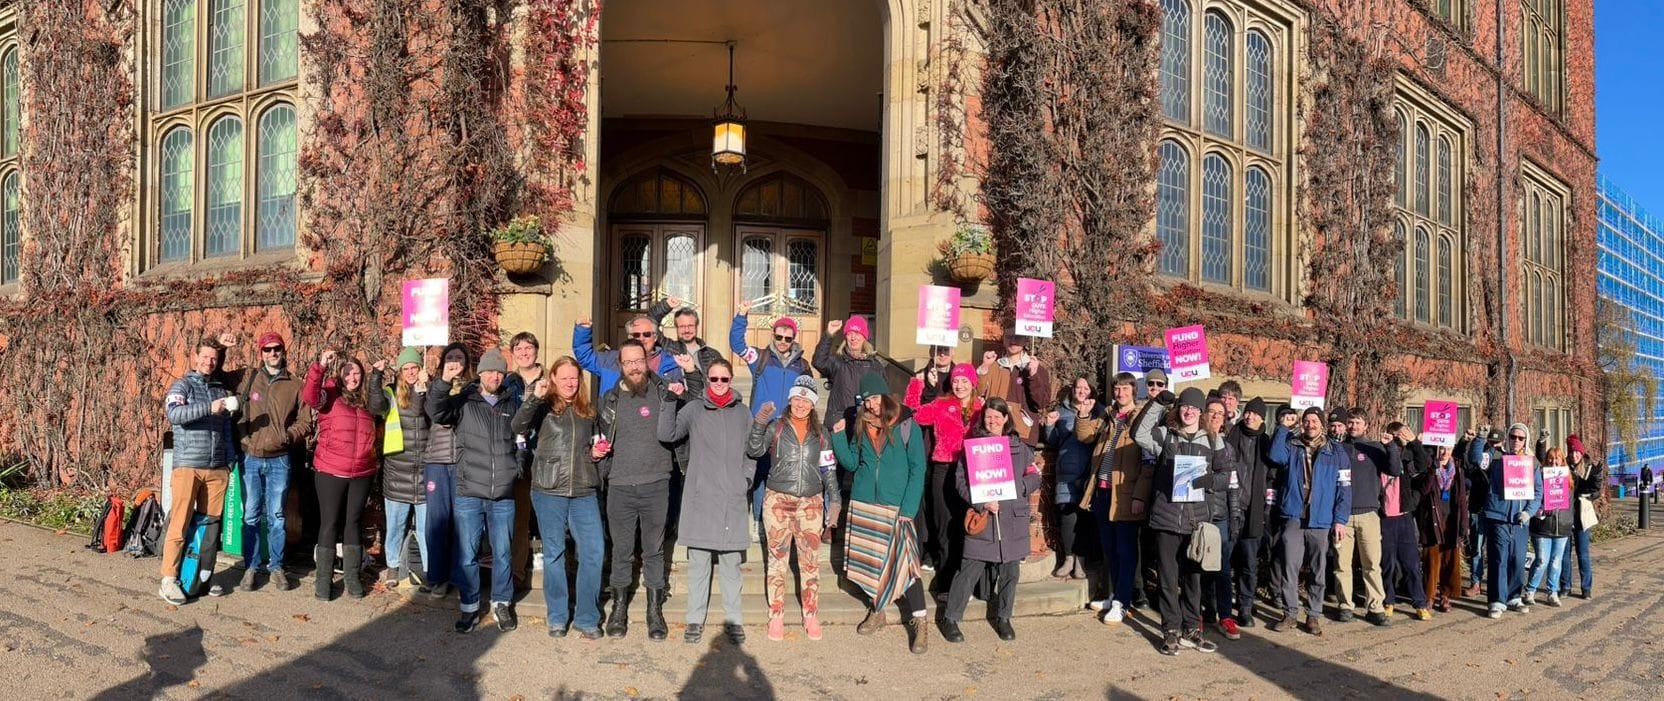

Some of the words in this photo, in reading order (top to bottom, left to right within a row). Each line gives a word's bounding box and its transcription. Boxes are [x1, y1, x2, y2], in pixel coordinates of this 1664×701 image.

[1024, 293, 1048, 303] STOP
[1171, 331, 1199, 343] FUND
[1172, 340, 1199, 350] Higher
[1138, 351, 1165, 361] University
[1175, 352, 1202, 365] NOW!
[1138, 359, 1172, 370] Sheffield
[1299, 373, 1320, 382] STOP
[1430, 411, 1451, 420] STOP
[972, 443, 1004, 455] FUND
[975, 467, 1008, 480] NOW!
[227, 472, 236, 519] RECYCLING
